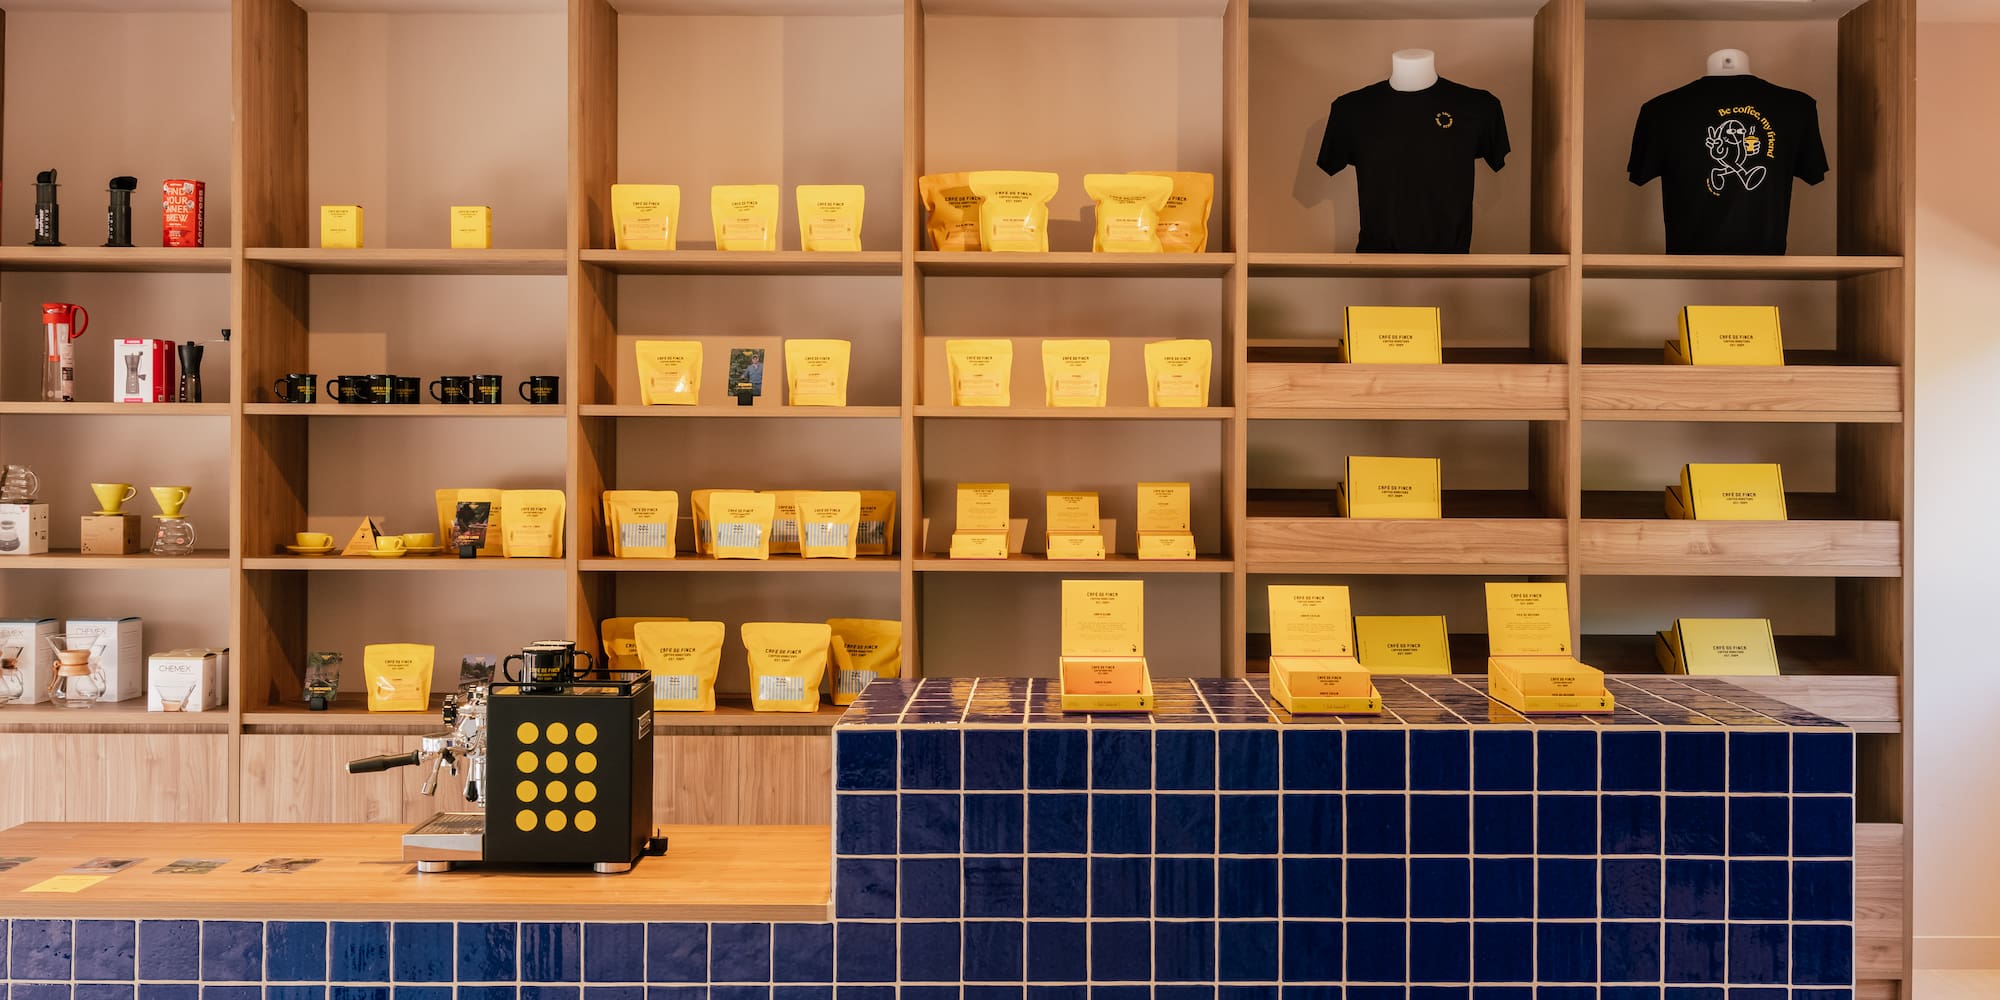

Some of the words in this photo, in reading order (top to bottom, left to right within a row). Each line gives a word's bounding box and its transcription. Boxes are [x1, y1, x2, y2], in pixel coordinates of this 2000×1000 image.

[1718, 108, 1732, 117] Be
[1732, 106, 1762, 120] coffee,
[1760, 118, 1771, 131] my
[1767, 131, 1776, 158] friend
[166, 213, 188, 222] BREW
